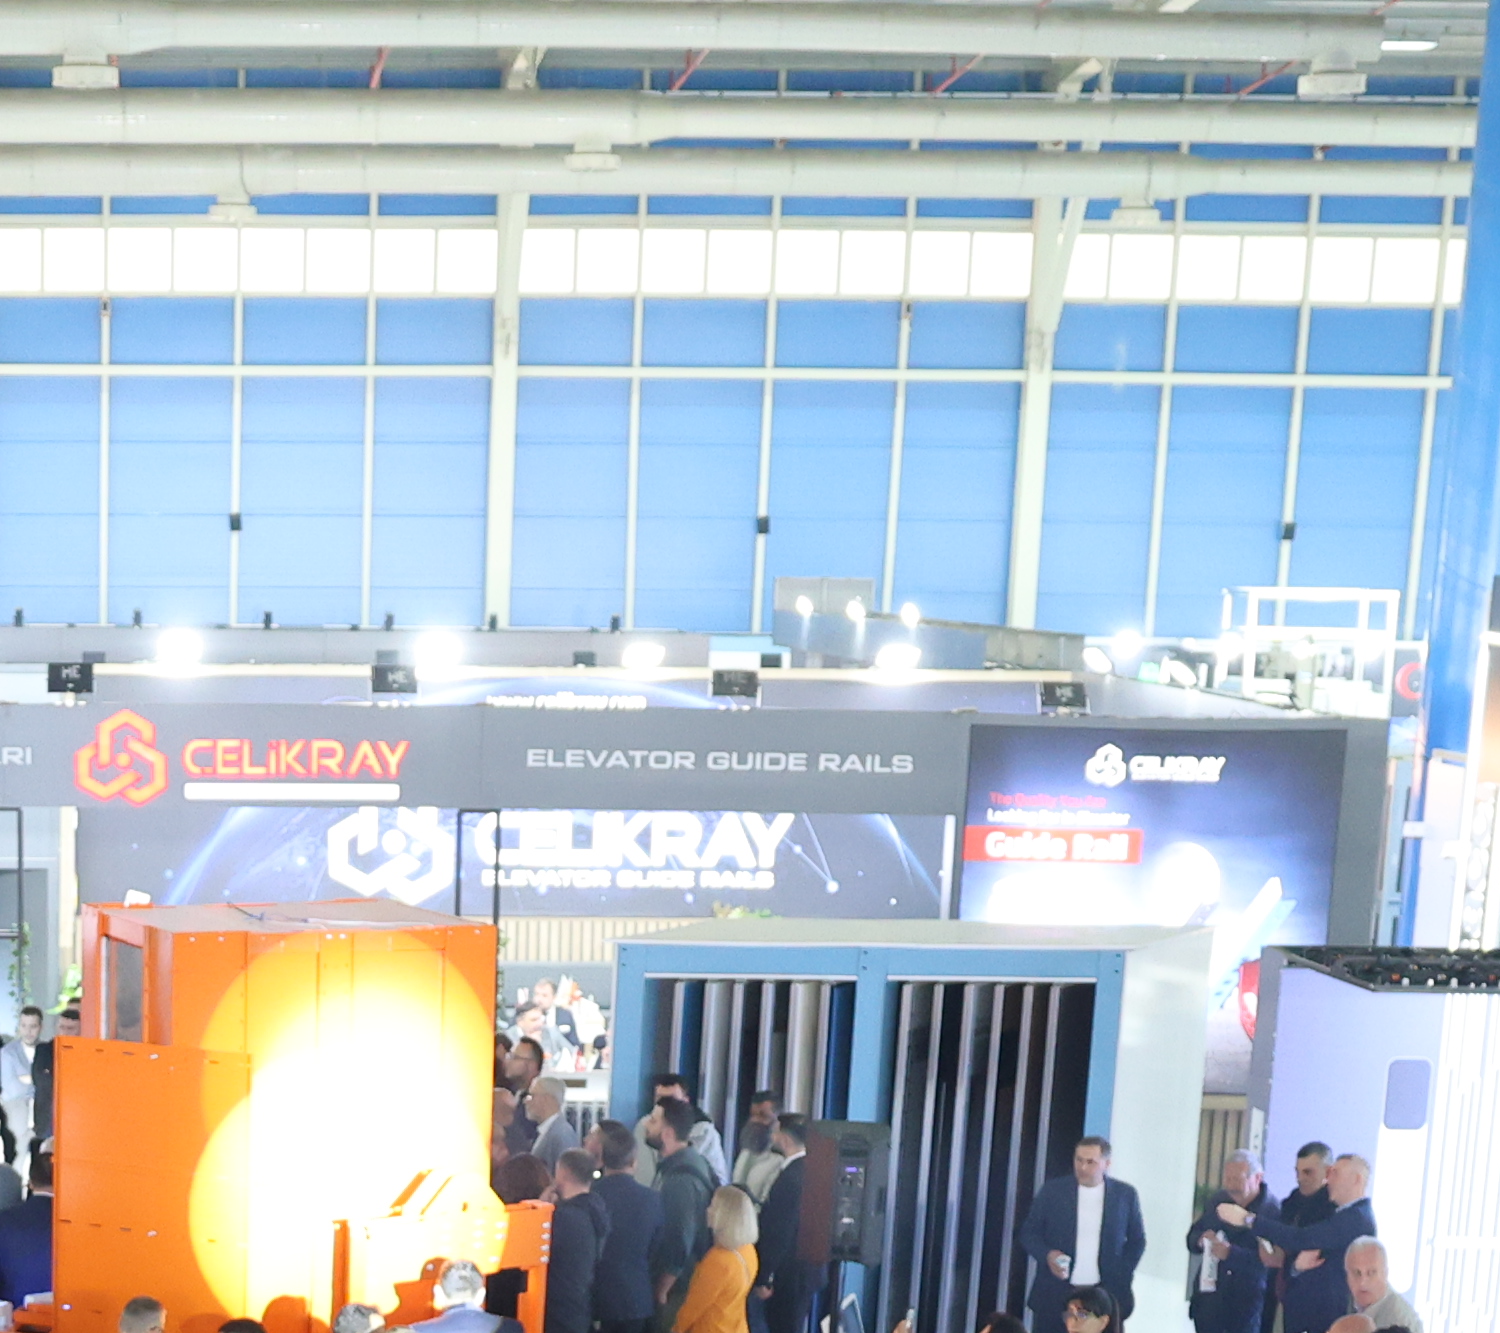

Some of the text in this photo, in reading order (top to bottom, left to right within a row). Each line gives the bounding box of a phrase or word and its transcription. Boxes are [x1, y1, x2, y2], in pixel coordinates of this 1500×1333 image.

[526, 748, 915, 774] ELEVATOR GUIDE RAILS
[984, 830, 1130, 861] Guide Rail
